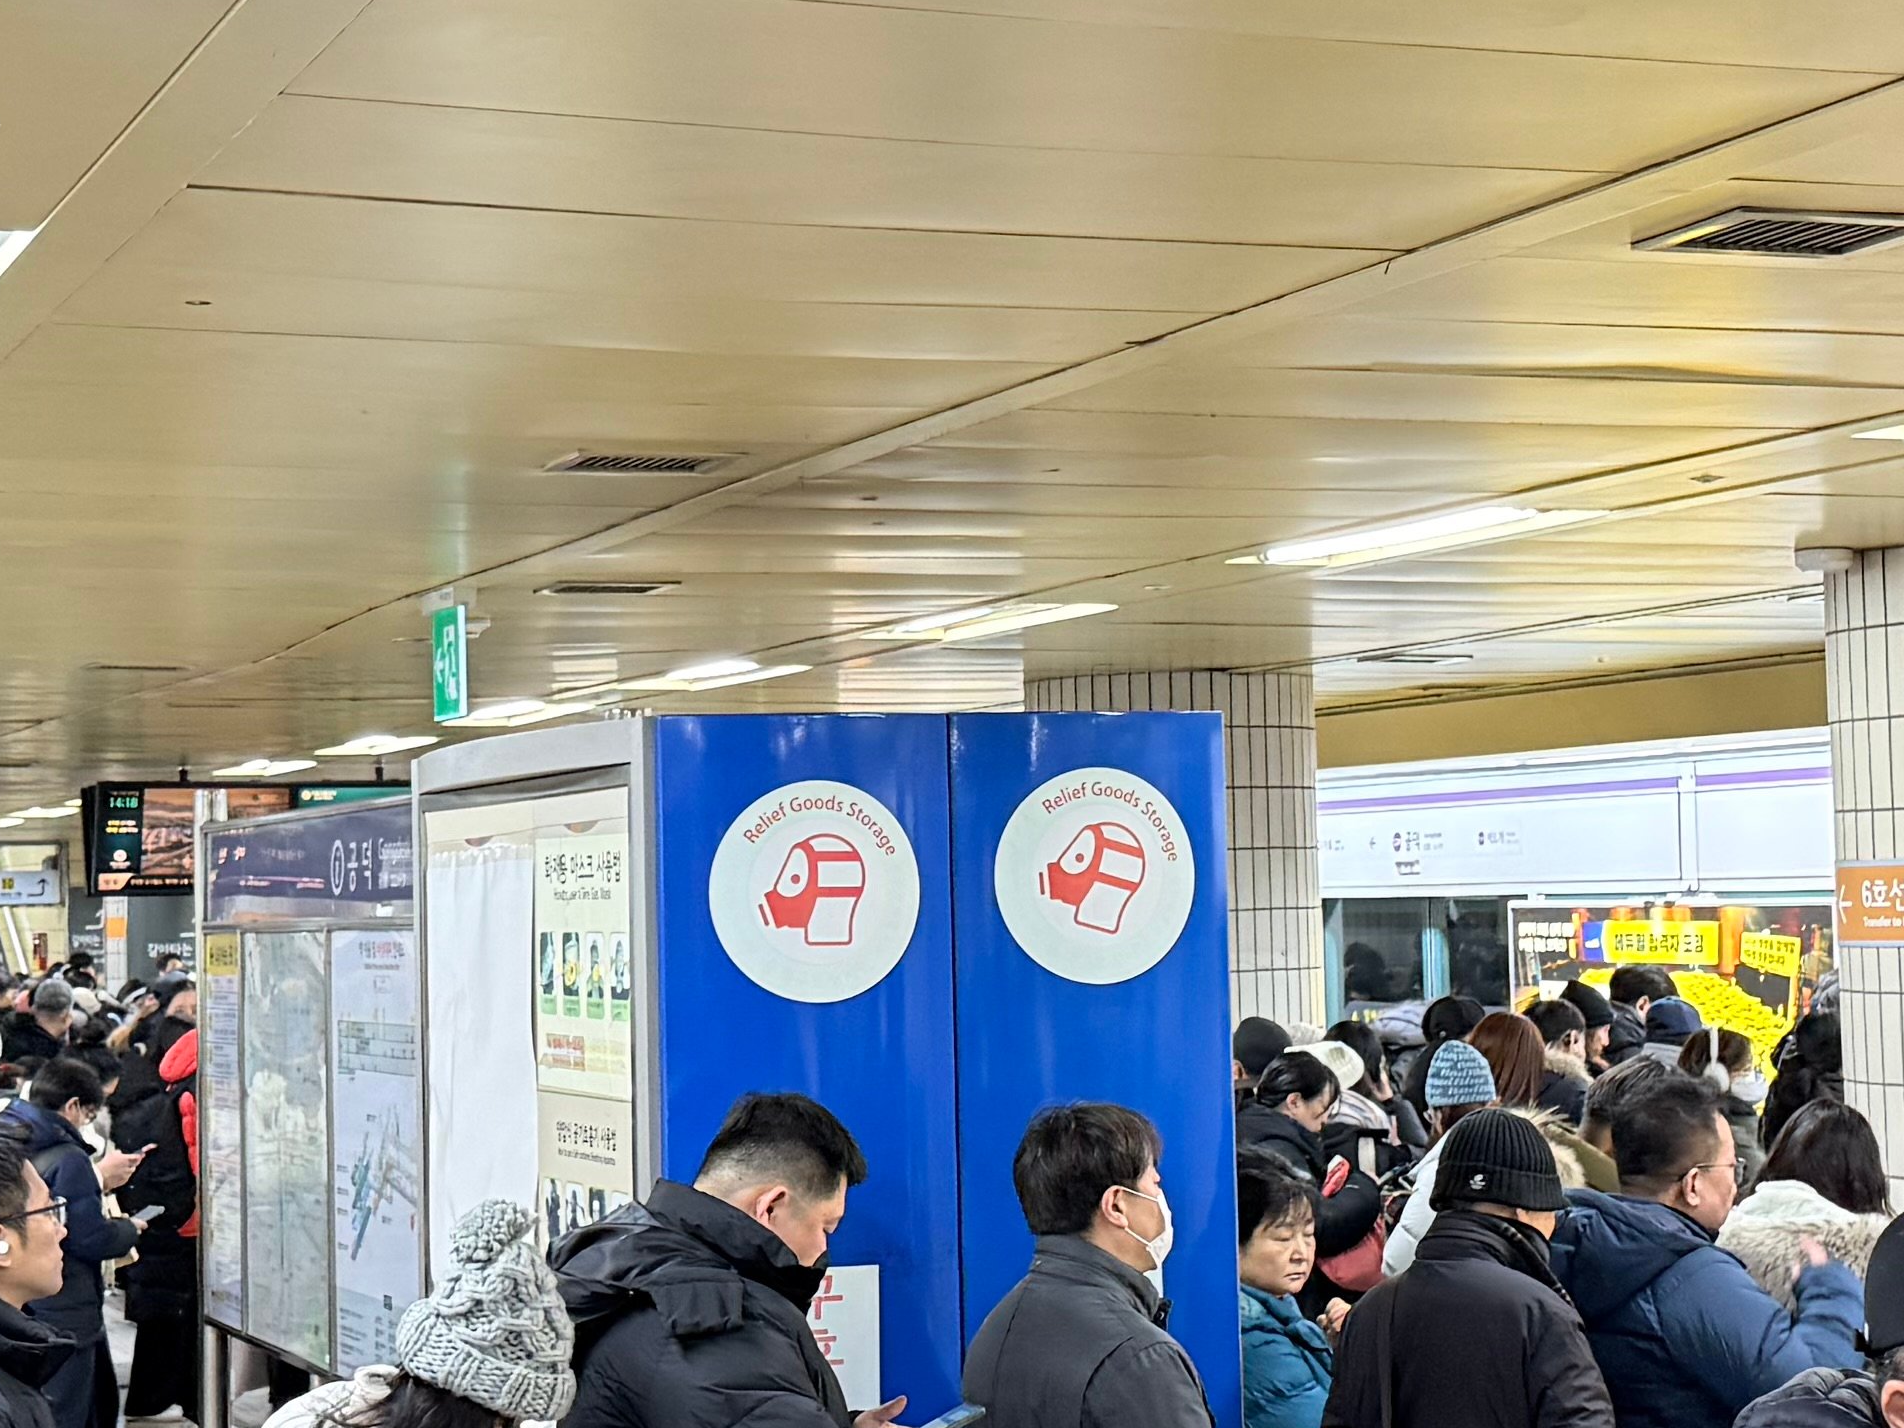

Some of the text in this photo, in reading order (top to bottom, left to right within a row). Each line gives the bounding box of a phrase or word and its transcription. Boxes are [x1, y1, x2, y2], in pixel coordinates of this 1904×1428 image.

[743, 795, 896, 856] Relief Goods Storage
[1041, 781, 1179, 862] Relief Goods Storage
